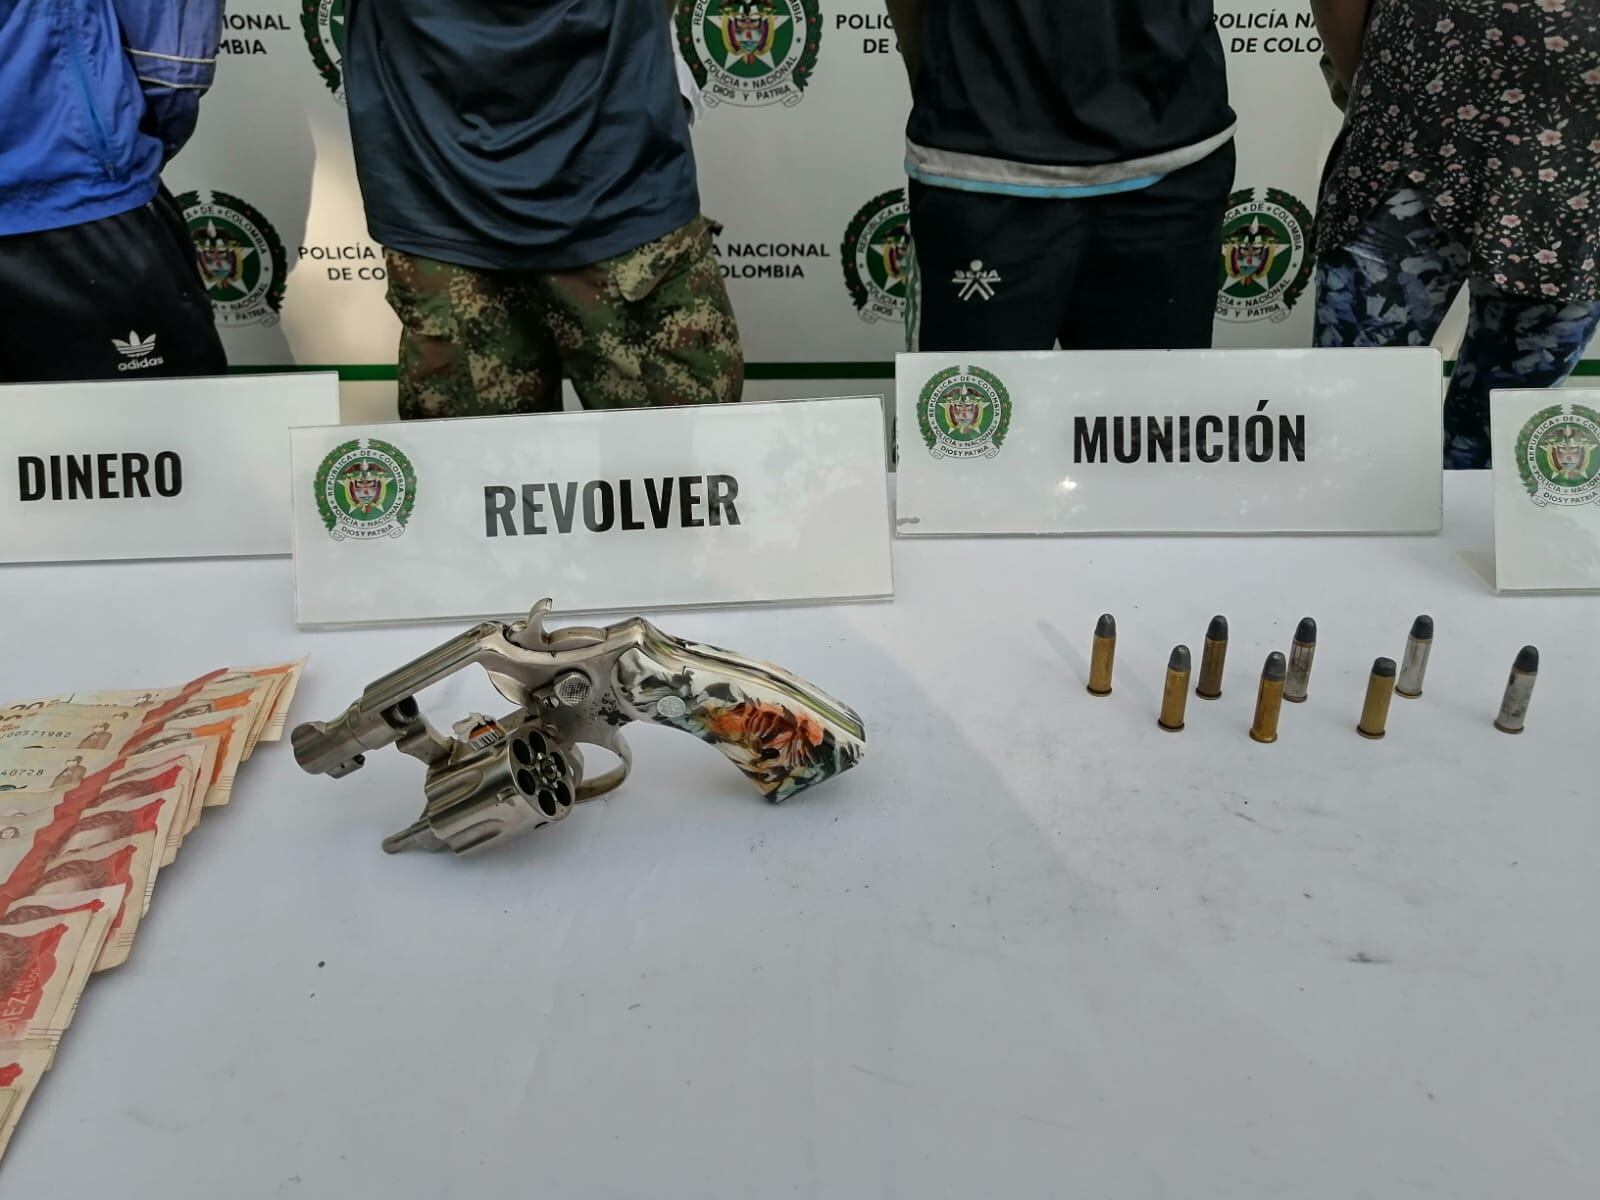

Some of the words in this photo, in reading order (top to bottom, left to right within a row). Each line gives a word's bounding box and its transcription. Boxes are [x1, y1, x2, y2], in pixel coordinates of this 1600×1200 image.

[863, 38, 889, 54] DE
[1231, 37, 1258, 53] DE
[1263, 37, 1325, 53] COLO
[752, 56, 798, 88] NACIONAL
[756, 84, 791, 100] PATRIA
[224, 208, 269, 255] COLOMBIA
[1249, 203, 1265, 213] DE
[1272, 206, 1303, 252] COLOMBIA
[298, 242, 376, 260] POLICÍA
[727, 243, 831, 258] NACIONAL
[327, 267, 353, 281] DE
[1244, 279, 1291, 307] NACIONAL
[1247, 303, 1281, 317] PATRIA
[118, 356, 165, 372] adidas
[977, 379, 1001, 417] COLOMBIA
[963, 424, 997, 448] NACIONAL
[1073, 399, 1306, 464] MUNICIÓN
[1528, 420, 1555, 462] REPUBLICA
[18, 450, 183, 502] DINERO
[379, 453, 405, 493] COLOMBIA
[331, 504, 359, 527] POLICIA
[367, 501, 402, 528] NACIONAL
[483, 474, 741, 538] REVOLVER
